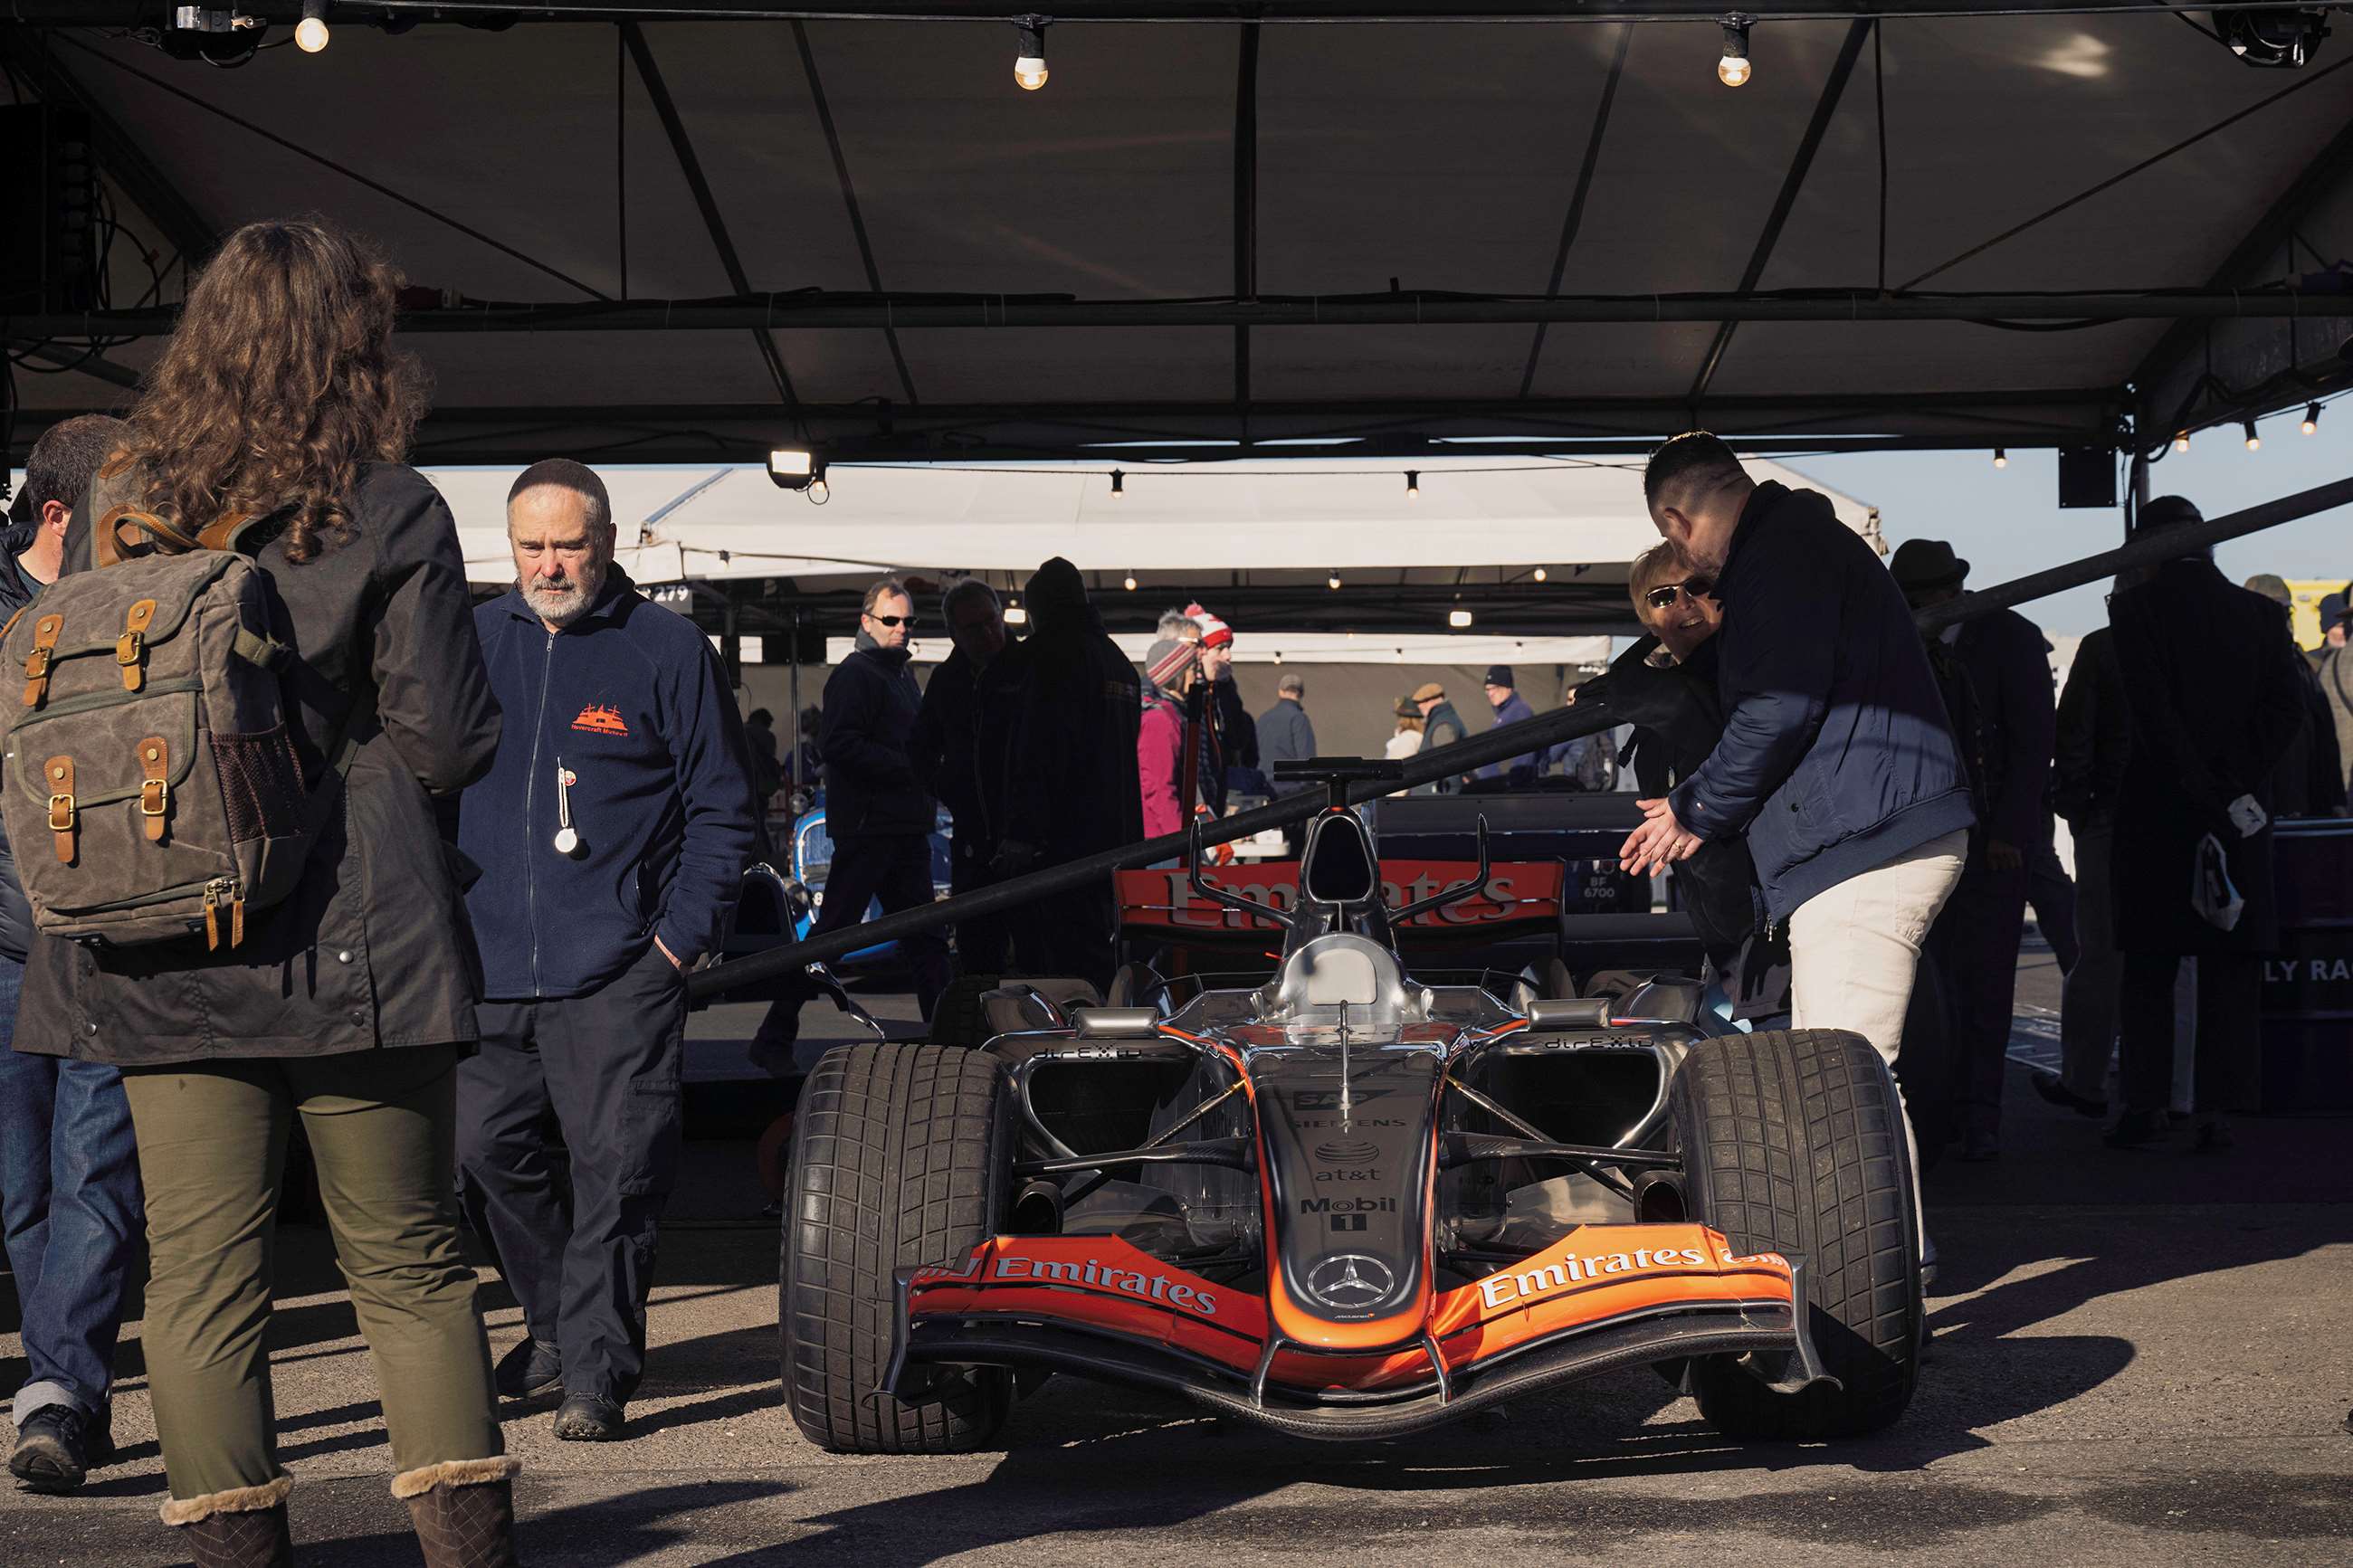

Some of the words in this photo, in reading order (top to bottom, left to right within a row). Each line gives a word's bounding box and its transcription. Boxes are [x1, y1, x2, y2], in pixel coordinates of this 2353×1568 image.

[654, 584, 689, 602] 279
[570, 723, 602, 734] Hovercraft
[1165, 870, 1519, 927] Emates
[1584, 887, 1615, 898] 6700
[2263, 959, 2300, 983] LY
[2310, 958, 2353, 982] RA
[1315, 1168, 1382, 1182] at&t
[1300, 1196, 1396, 1215] Mobil
[995, 1257, 1216, 1315] Emirates
[1479, 1246, 1704, 1309] Emirates
